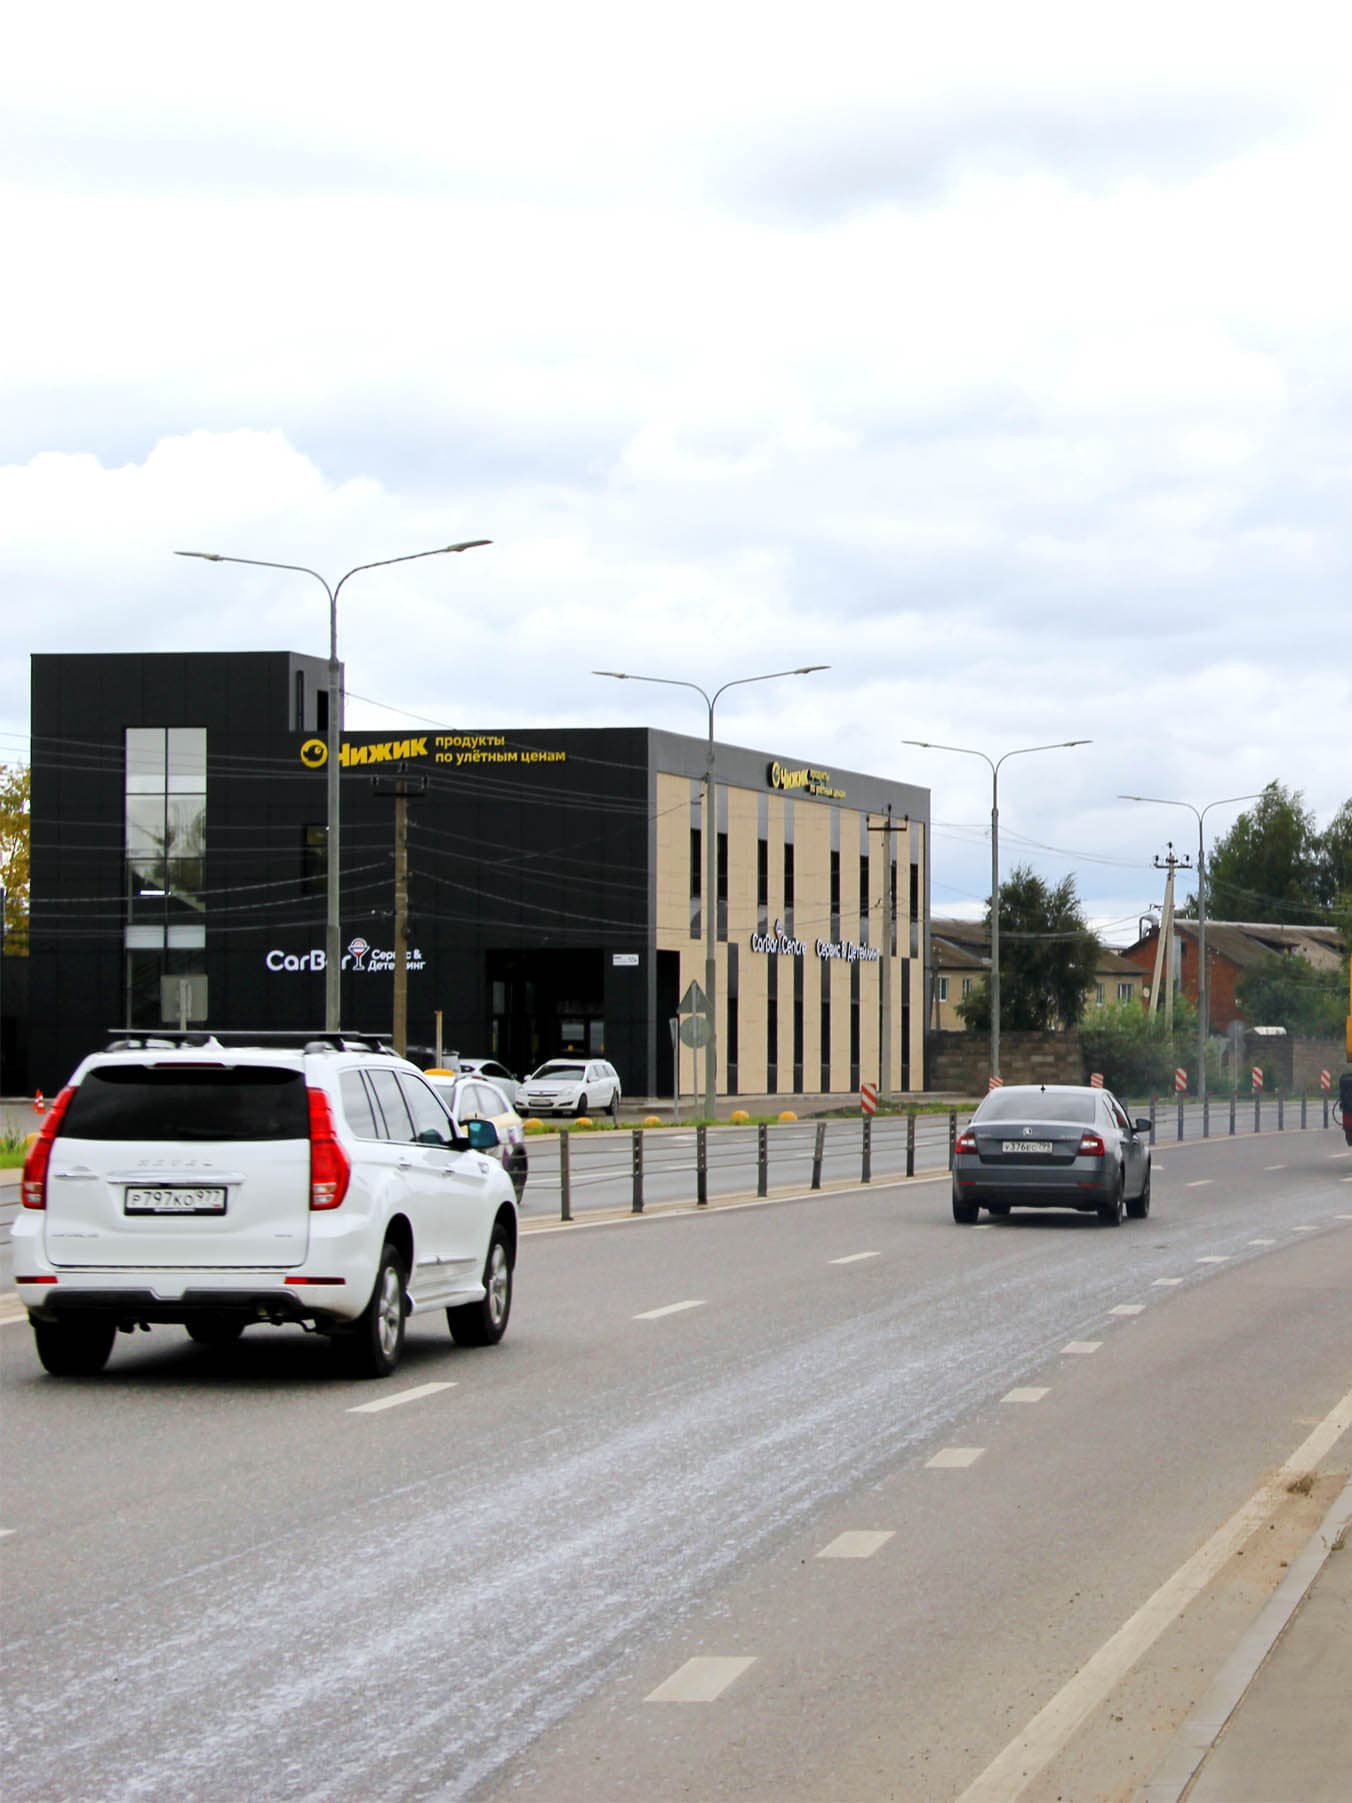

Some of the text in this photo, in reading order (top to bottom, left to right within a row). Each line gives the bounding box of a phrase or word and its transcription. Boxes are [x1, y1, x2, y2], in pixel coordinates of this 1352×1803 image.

[435, 736, 505, 749] продукты
[435, 750, 566, 766] по улётным ценам
[266, 949, 351, 971] CarBr
[371, 949, 422, 961] Серс &
[368, 960, 426, 972] Детеинг
